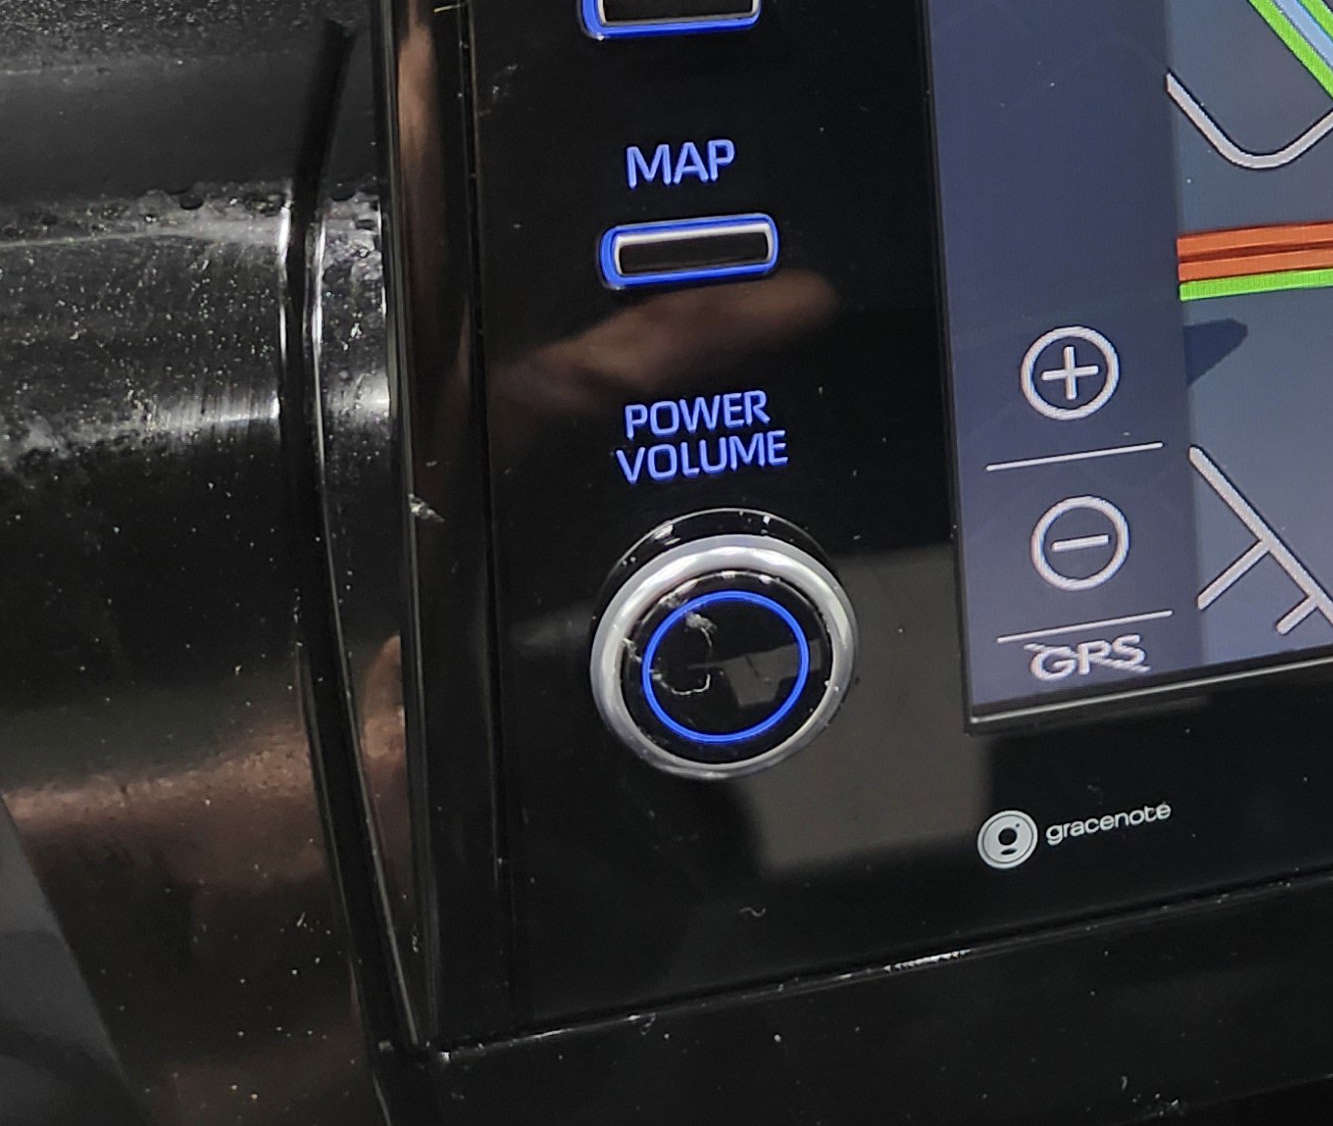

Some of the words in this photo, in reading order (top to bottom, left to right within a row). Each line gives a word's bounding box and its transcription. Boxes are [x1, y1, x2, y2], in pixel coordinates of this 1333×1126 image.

[625, 139, 735, 188] MAP
[624, 390, 770, 439] POWER
[616, 430, 789, 484] VOLUME
[1028, 634, 1148, 681] GPS
[1045, 802, 1172, 846] gracenote
